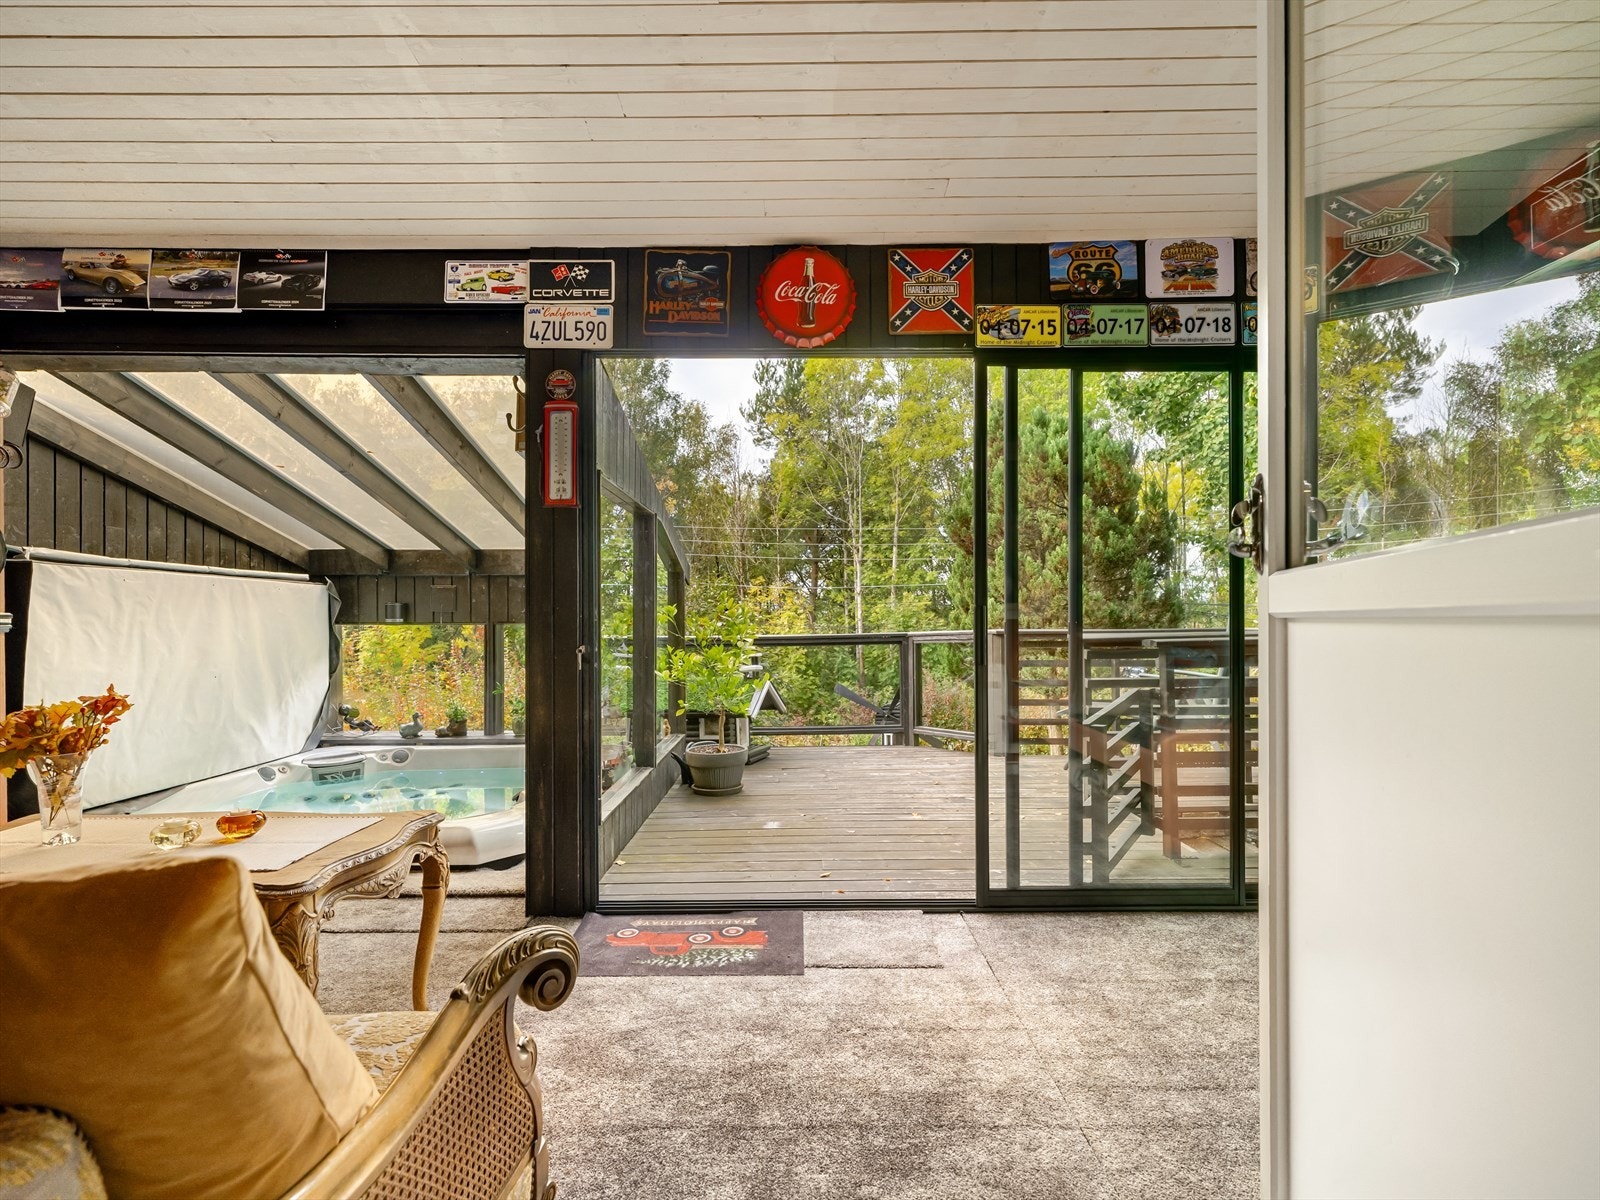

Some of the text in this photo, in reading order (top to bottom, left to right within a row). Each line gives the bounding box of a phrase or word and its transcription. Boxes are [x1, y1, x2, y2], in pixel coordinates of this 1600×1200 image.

[1074, 249, 1111, 258] ROUTE
[532, 289, 610, 297] CORVETTE
[908, 285, 954, 294] HARLEY-DAVIDSON
[649, 300, 692, 314] HARLEY
[543, 307, 597, 320] California
[668, 311, 720, 322] DAVIDSON
[529, 320, 607, 342] 4ZUL590
[635, 918, 708, 926] HOLIDAYS
